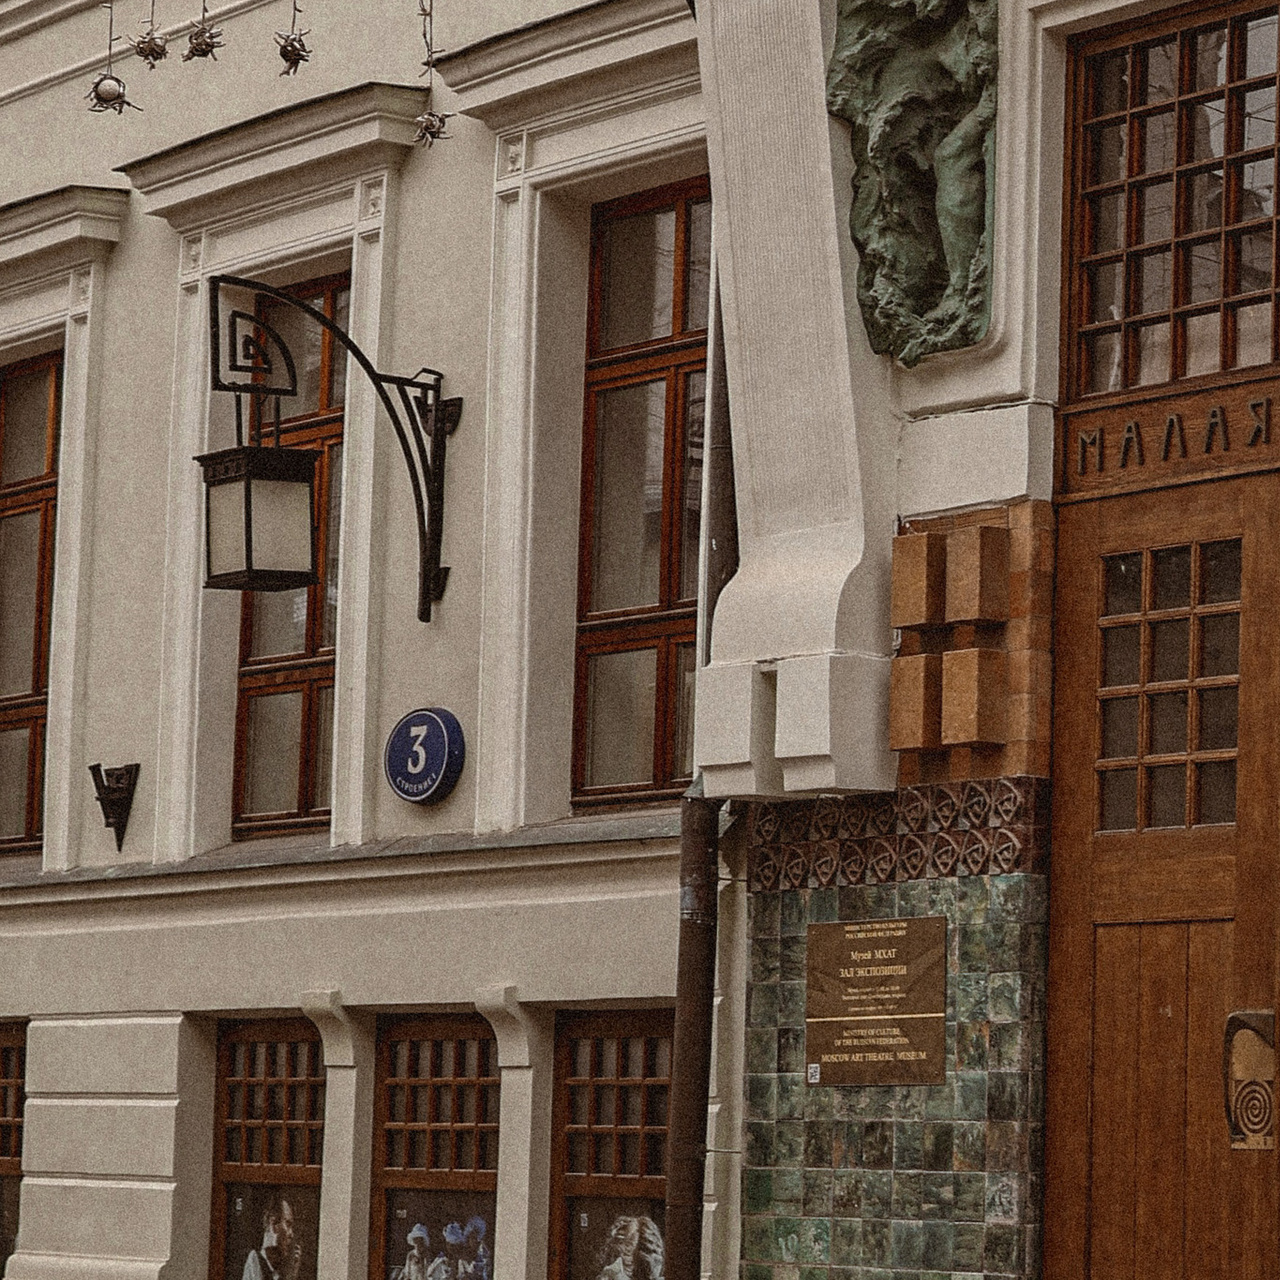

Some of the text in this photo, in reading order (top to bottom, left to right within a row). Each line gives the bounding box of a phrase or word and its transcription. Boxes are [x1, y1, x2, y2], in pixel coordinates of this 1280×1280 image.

[1078, 396, 1272, 476] МАЛАЯ
[407, 725, 427, 774] 3
[396, 777, 432, 792] СТРОЕНИЕ
[851, 948, 898, 962] Музей МХАТ
[840, 968, 855, 978] ЗАЛ
[821, 1051, 927, 1062] MOSCOW ART THEATRE MUSEUM
